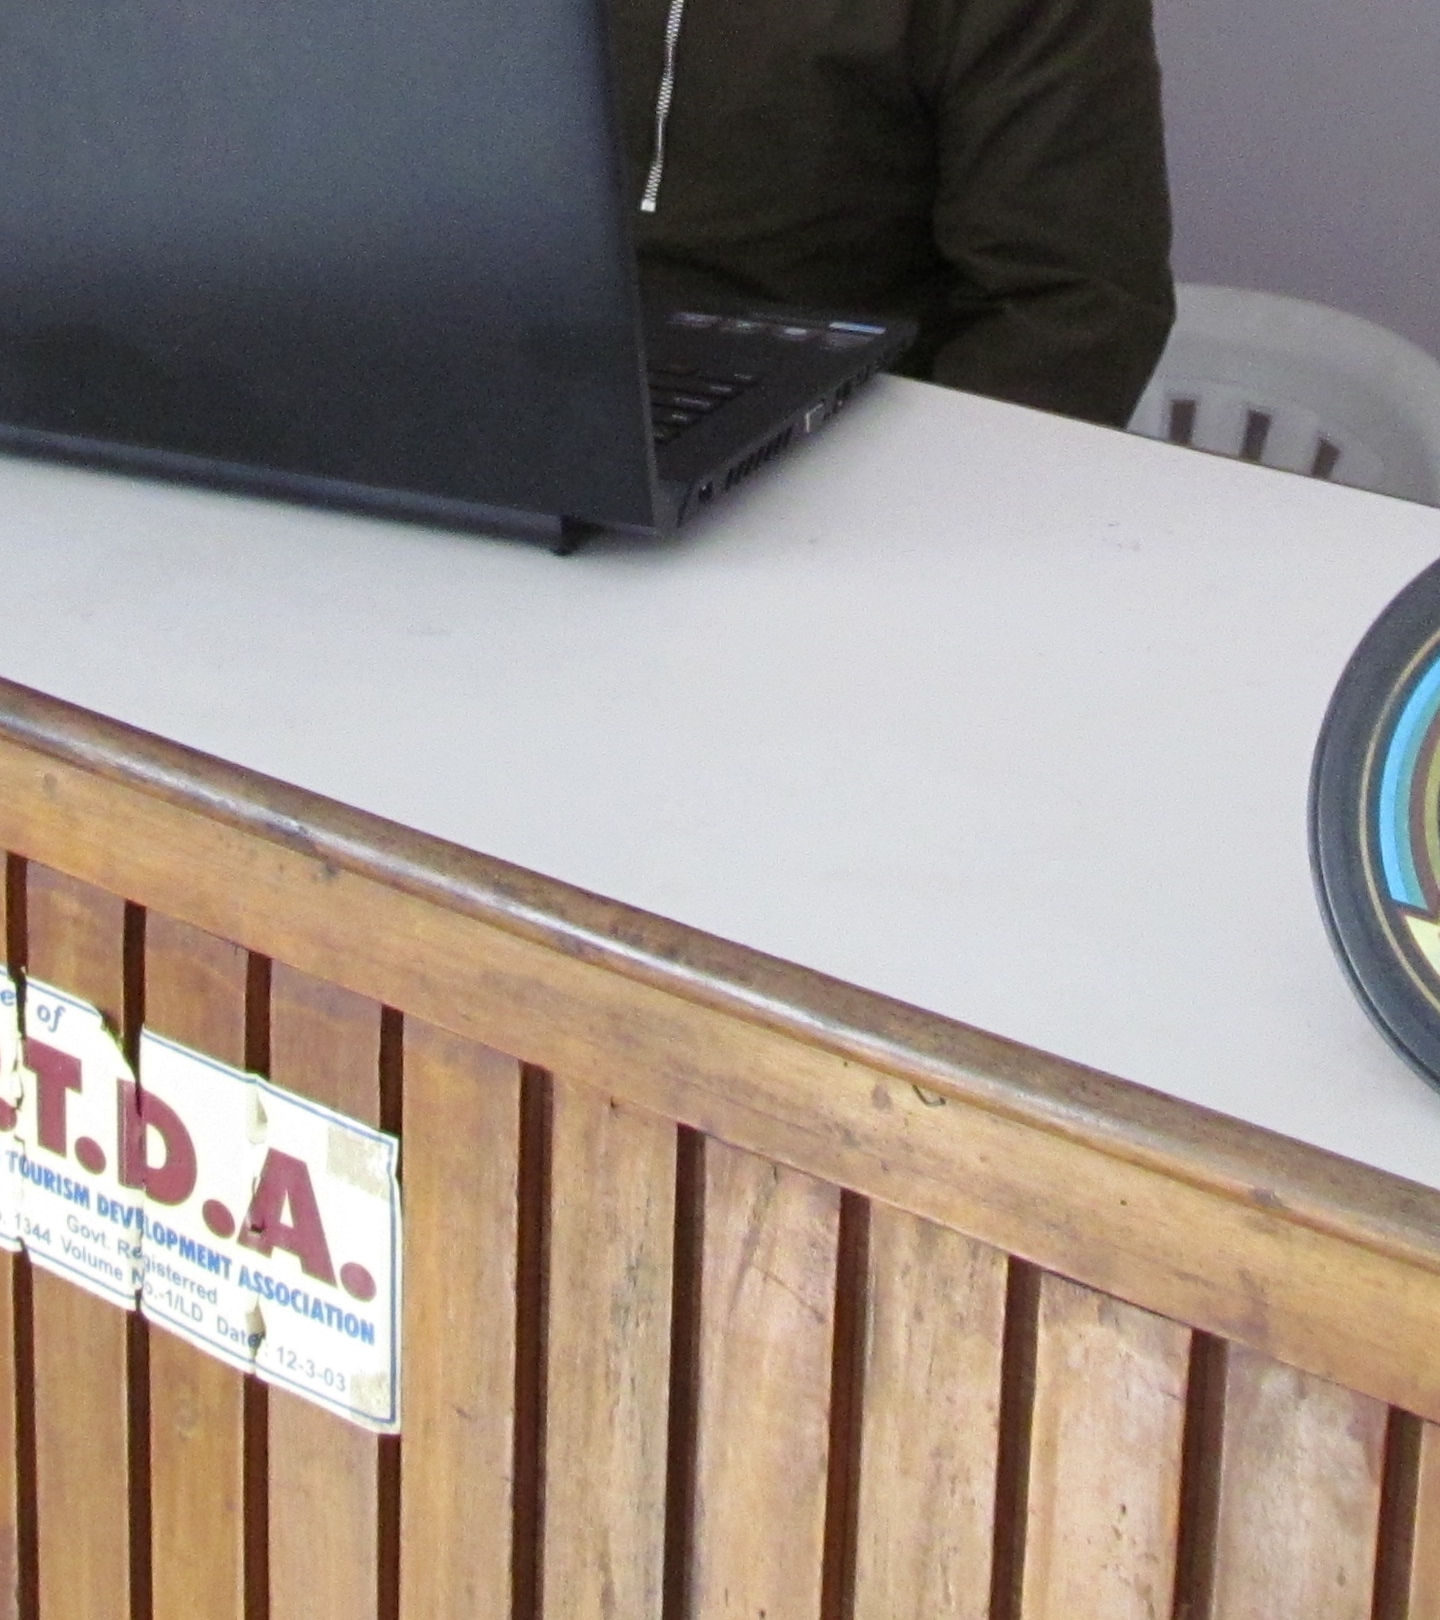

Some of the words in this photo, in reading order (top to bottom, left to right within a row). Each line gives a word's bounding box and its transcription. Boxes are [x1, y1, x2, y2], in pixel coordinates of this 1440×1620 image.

[36, 1003, 67, 1033] of
[5, 1149, 91, 1210] TOURISM
[238, 1264, 375, 1346] ASSOCIATION
[66, 1213, 111, 1250] Govt.
[14, 1212, 52, 1245] 1344
[60, 1235, 124, 1282] Volume
[276, 1345, 347, 1393] 12-3-03
